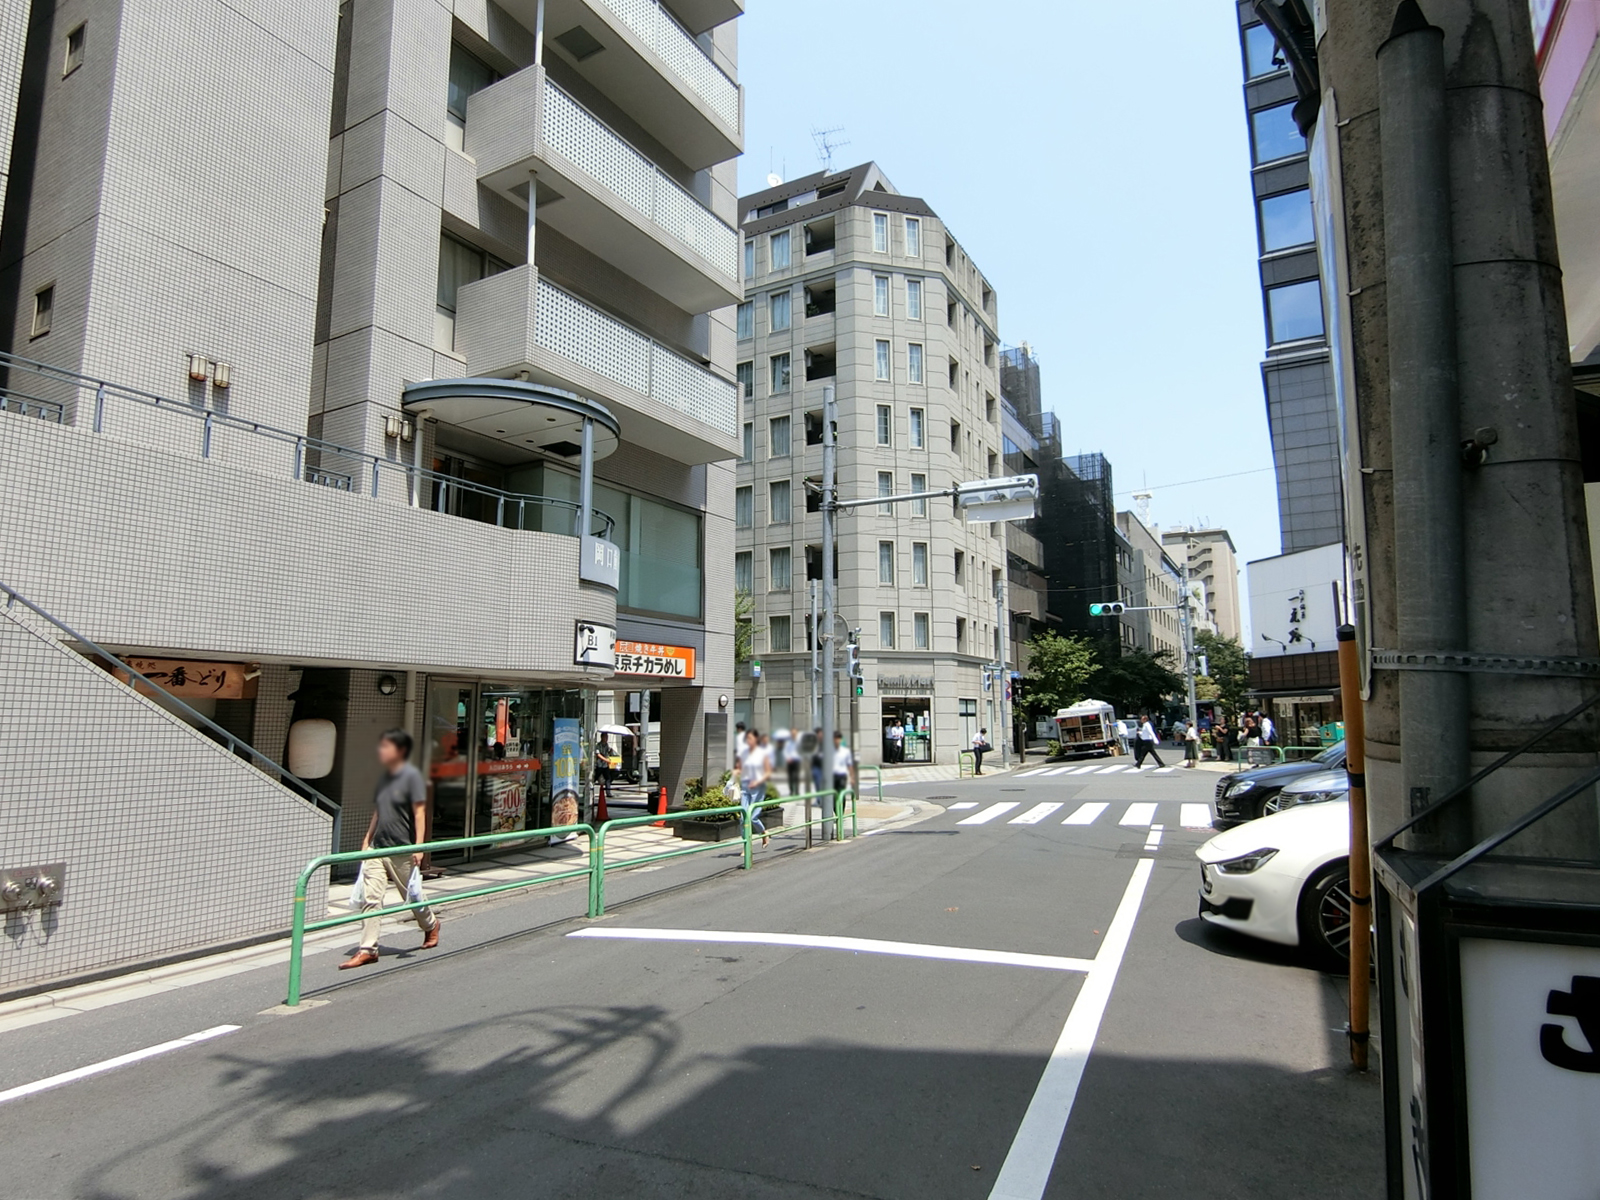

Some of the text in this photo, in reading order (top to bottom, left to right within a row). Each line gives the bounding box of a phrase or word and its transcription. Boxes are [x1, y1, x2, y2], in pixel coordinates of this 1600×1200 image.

[587, 635, 598, 647] B1
[142, 666, 226, 693] 一番どり
